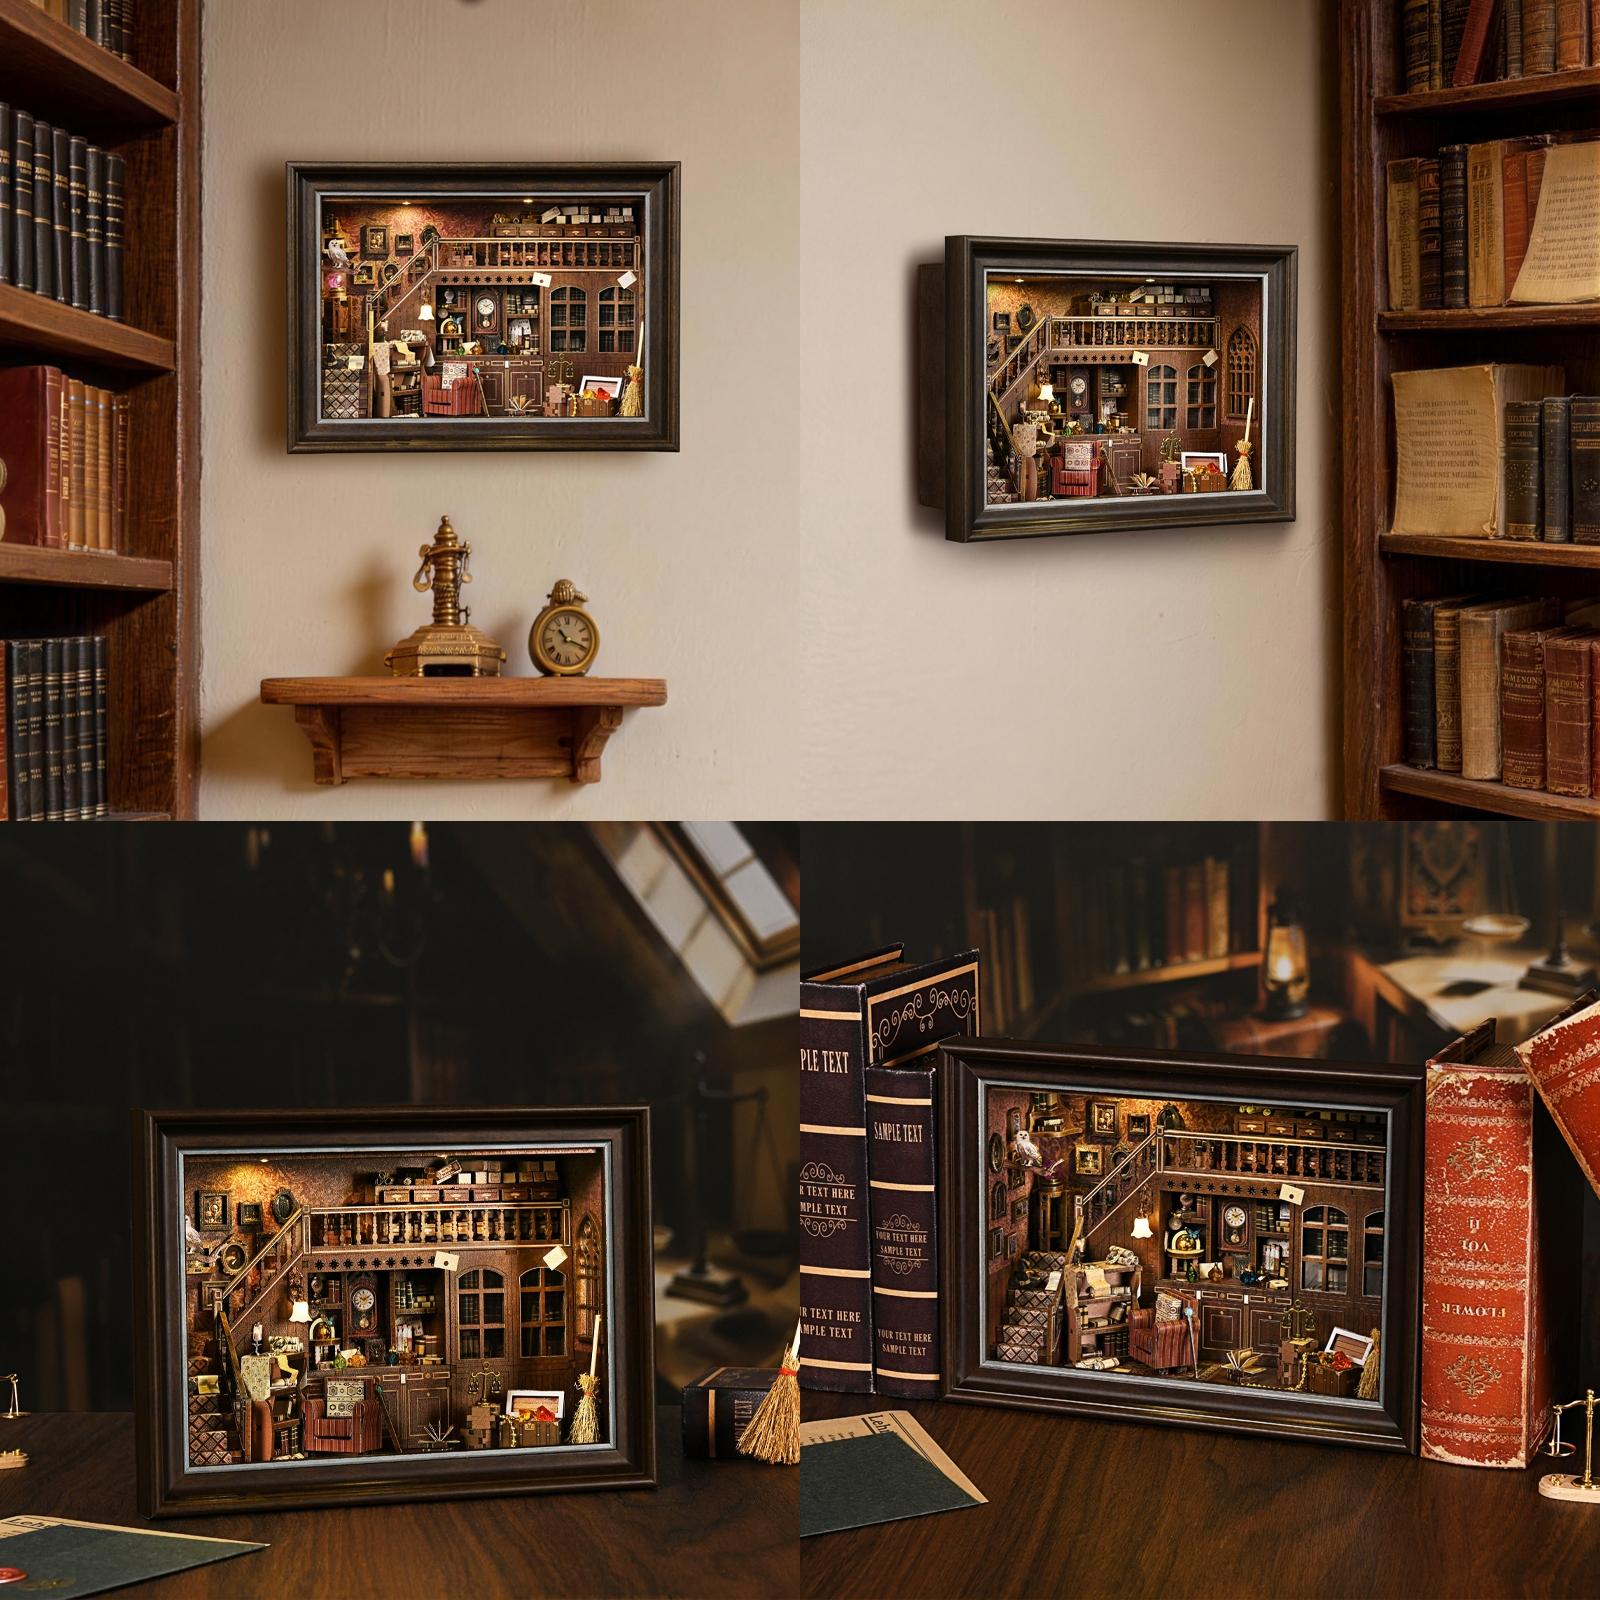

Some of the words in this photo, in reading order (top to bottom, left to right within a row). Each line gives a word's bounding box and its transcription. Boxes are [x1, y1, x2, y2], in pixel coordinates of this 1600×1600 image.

[822, 1050, 849, 1074] TEXT
[874, 1121, 901, 1142] SAMPLE
[903, 1124, 923, 1143] TEXT
[807, 1186, 829, 1198] TEXT
[832, 1188, 855, 1200] HERE
[825, 1204, 848, 1216] TEXT
[876, 1230, 891, 1241] YOUR
[892, 1232, 908, 1243] TEXT
[910, 1234, 928, 1244] HERE
[880, 1244, 904, 1256] SAMPLE
[905, 1247, 922, 1257] TEXT
[810, 1307, 834, 1320] TEXT
[836, 1310, 861, 1323] HERE
[1441, 1302, 1505, 1318] FLOWER
[829, 1326, 853, 1339] TEXT
[878, 1328, 894, 1339] YOUR
[895, 1331, 911, 1342] TEXT
[913, 1333, 933, 1343] HERE
[882, 1343, 907, 1355] SAMPLE
[908, 1346, 927, 1356] TEXT
